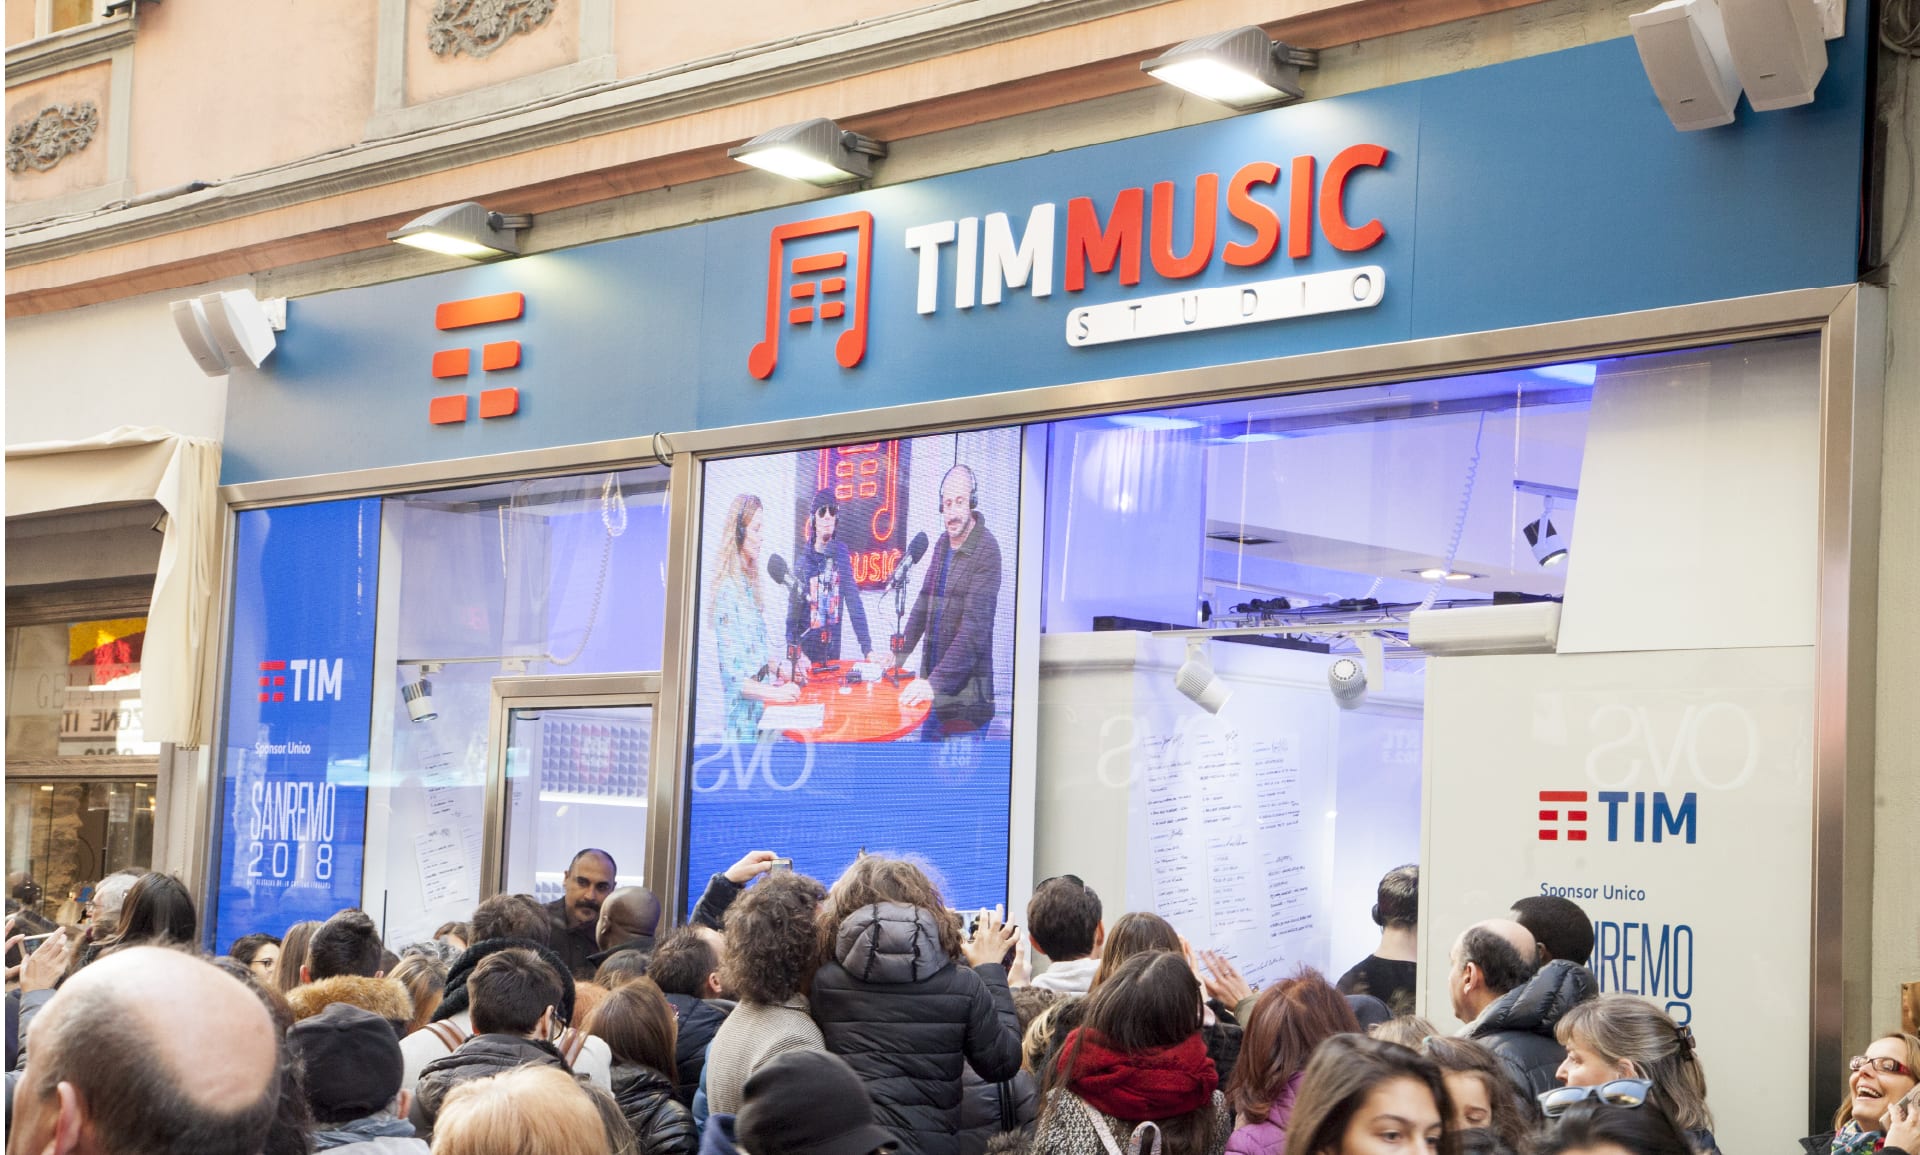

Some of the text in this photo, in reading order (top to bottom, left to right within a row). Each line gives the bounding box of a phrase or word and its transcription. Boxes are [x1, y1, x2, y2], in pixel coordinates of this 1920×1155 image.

[1075, 272, 1373, 341] STUDIO
[849, 549, 902, 584] USIC
[290, 658, 343, 702] TIM
[254, 740, 311, 758] Sponsor Unico
[250, 781, 336, 843] SANREMO
[1598, 791, 1697, 844] TIM
[247, 841, 333, 880] 2018
[1540, 882, 1646, 901] Sponsor Unico
